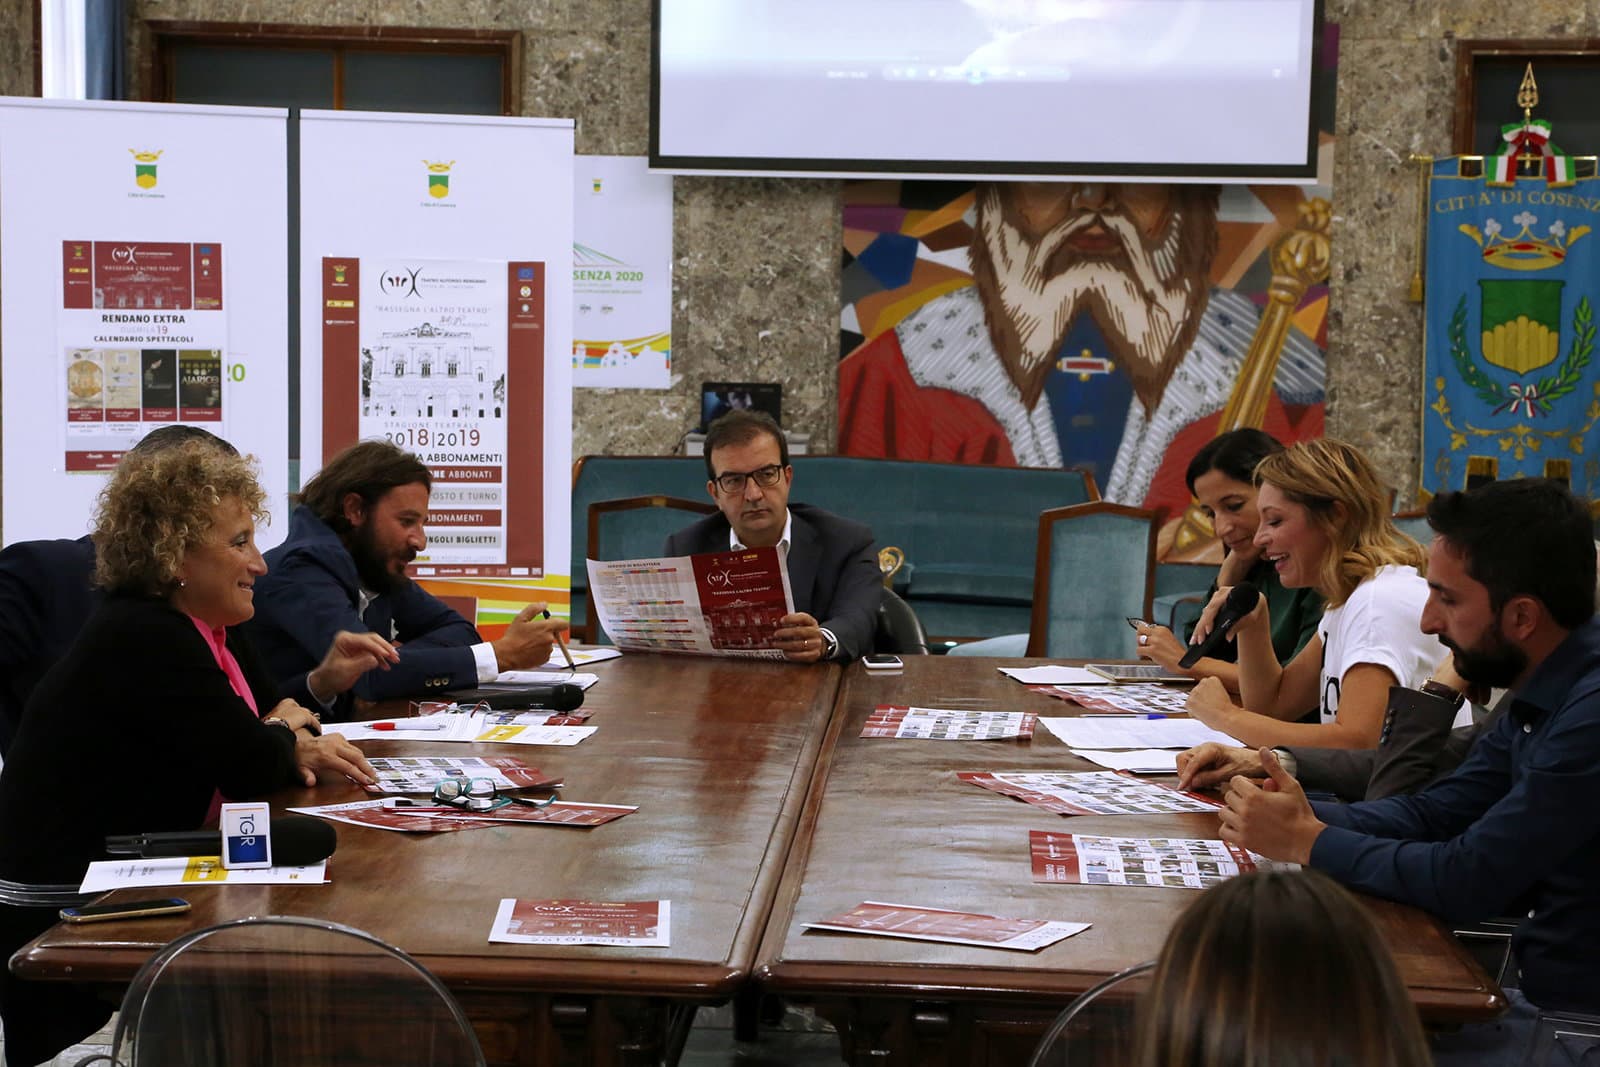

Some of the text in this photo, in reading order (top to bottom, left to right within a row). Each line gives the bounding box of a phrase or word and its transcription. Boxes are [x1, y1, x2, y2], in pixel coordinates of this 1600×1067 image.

[1502, 191, 1522, 205] DI
[615, 271, 644, 281] 2020
[101, 314, 186, 324] RENDANO EXTRA
[426, 454, 502, 463] ABBONAMENTI
[448, 470, 493, 479] ABBONATI
[431, 492, 498, 500] OSTO E TURNO
[456, 536, 497, 544] BIGLIETTI
[239, 813, 256, 847] TGR
